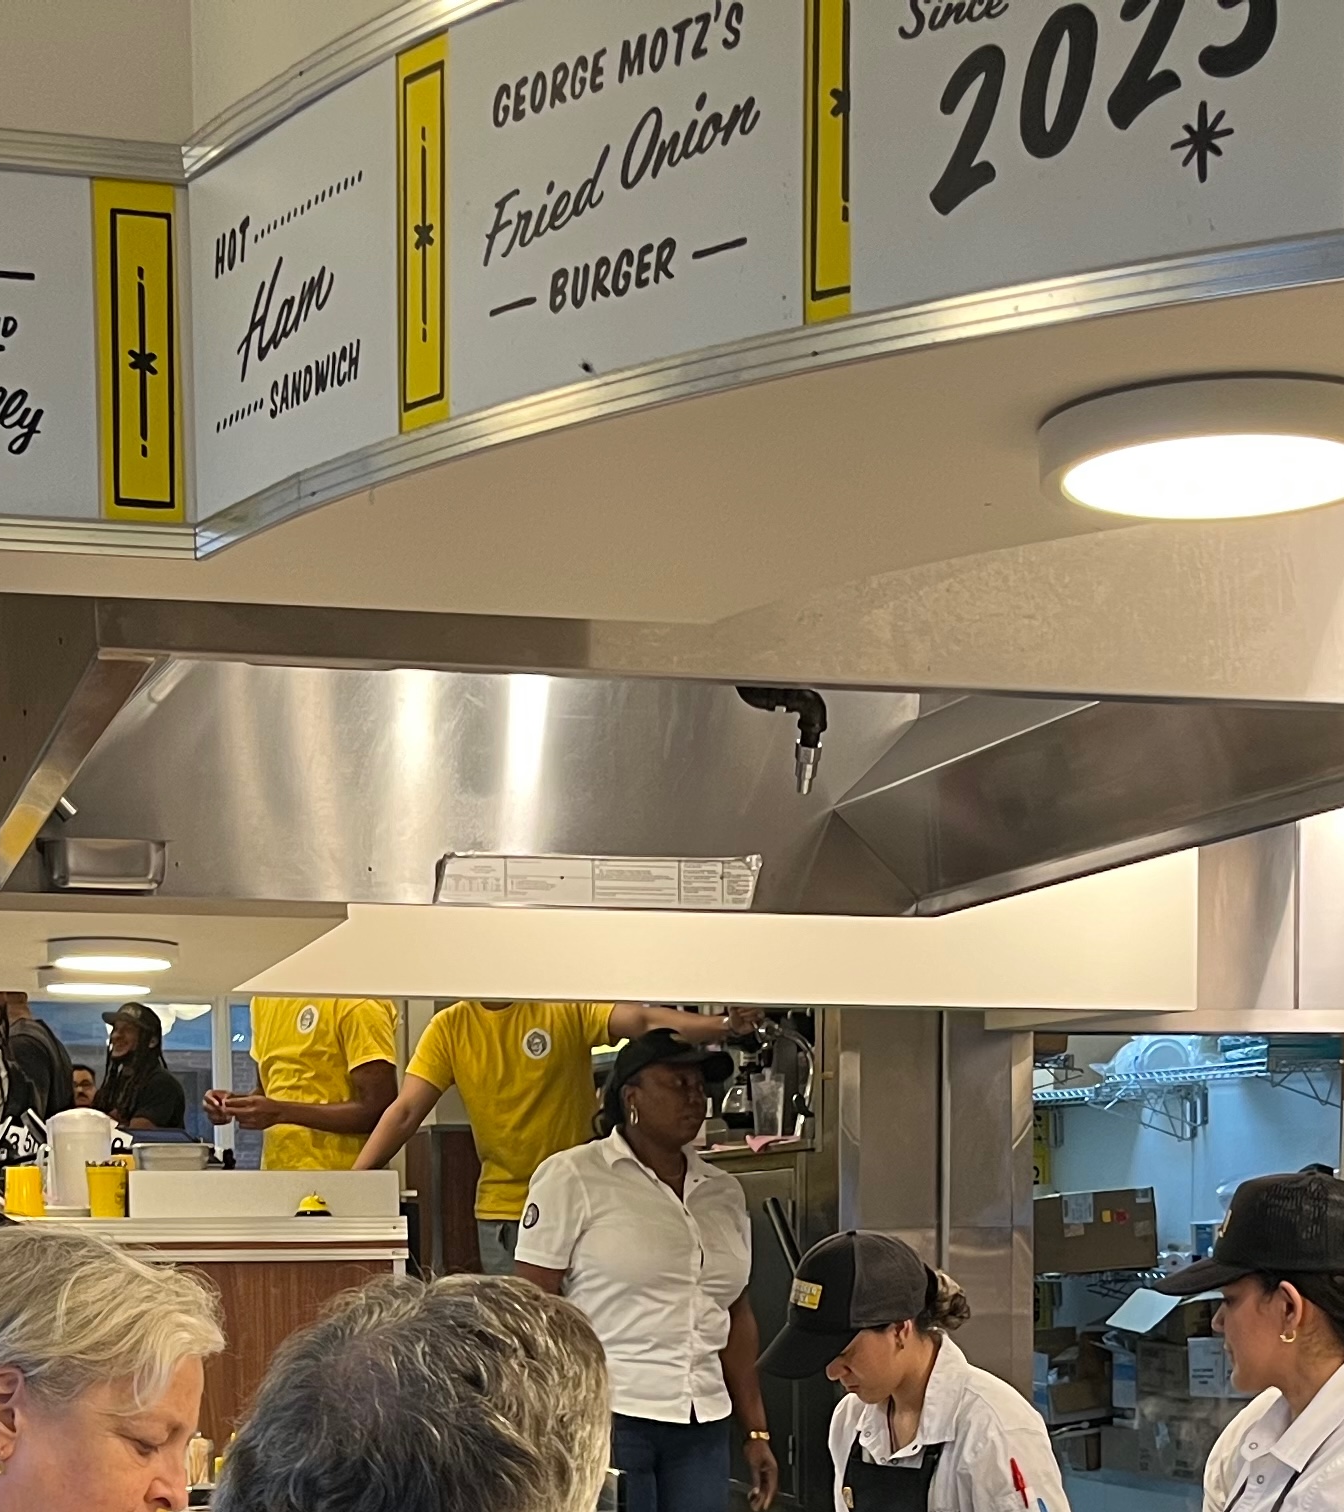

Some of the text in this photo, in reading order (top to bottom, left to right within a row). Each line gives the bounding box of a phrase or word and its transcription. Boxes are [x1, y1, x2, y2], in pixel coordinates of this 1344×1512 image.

[493, 0, 744, 128] GEORGE MOTZ'S
[483, 91, 761, 267] Fried Onion
[214, 215, 250, 280] HOT
[549, 236, 677, 314] BURGER
[238, 256, 335, 382] Ham
[269, 338, 361, 420] SANDWICH
